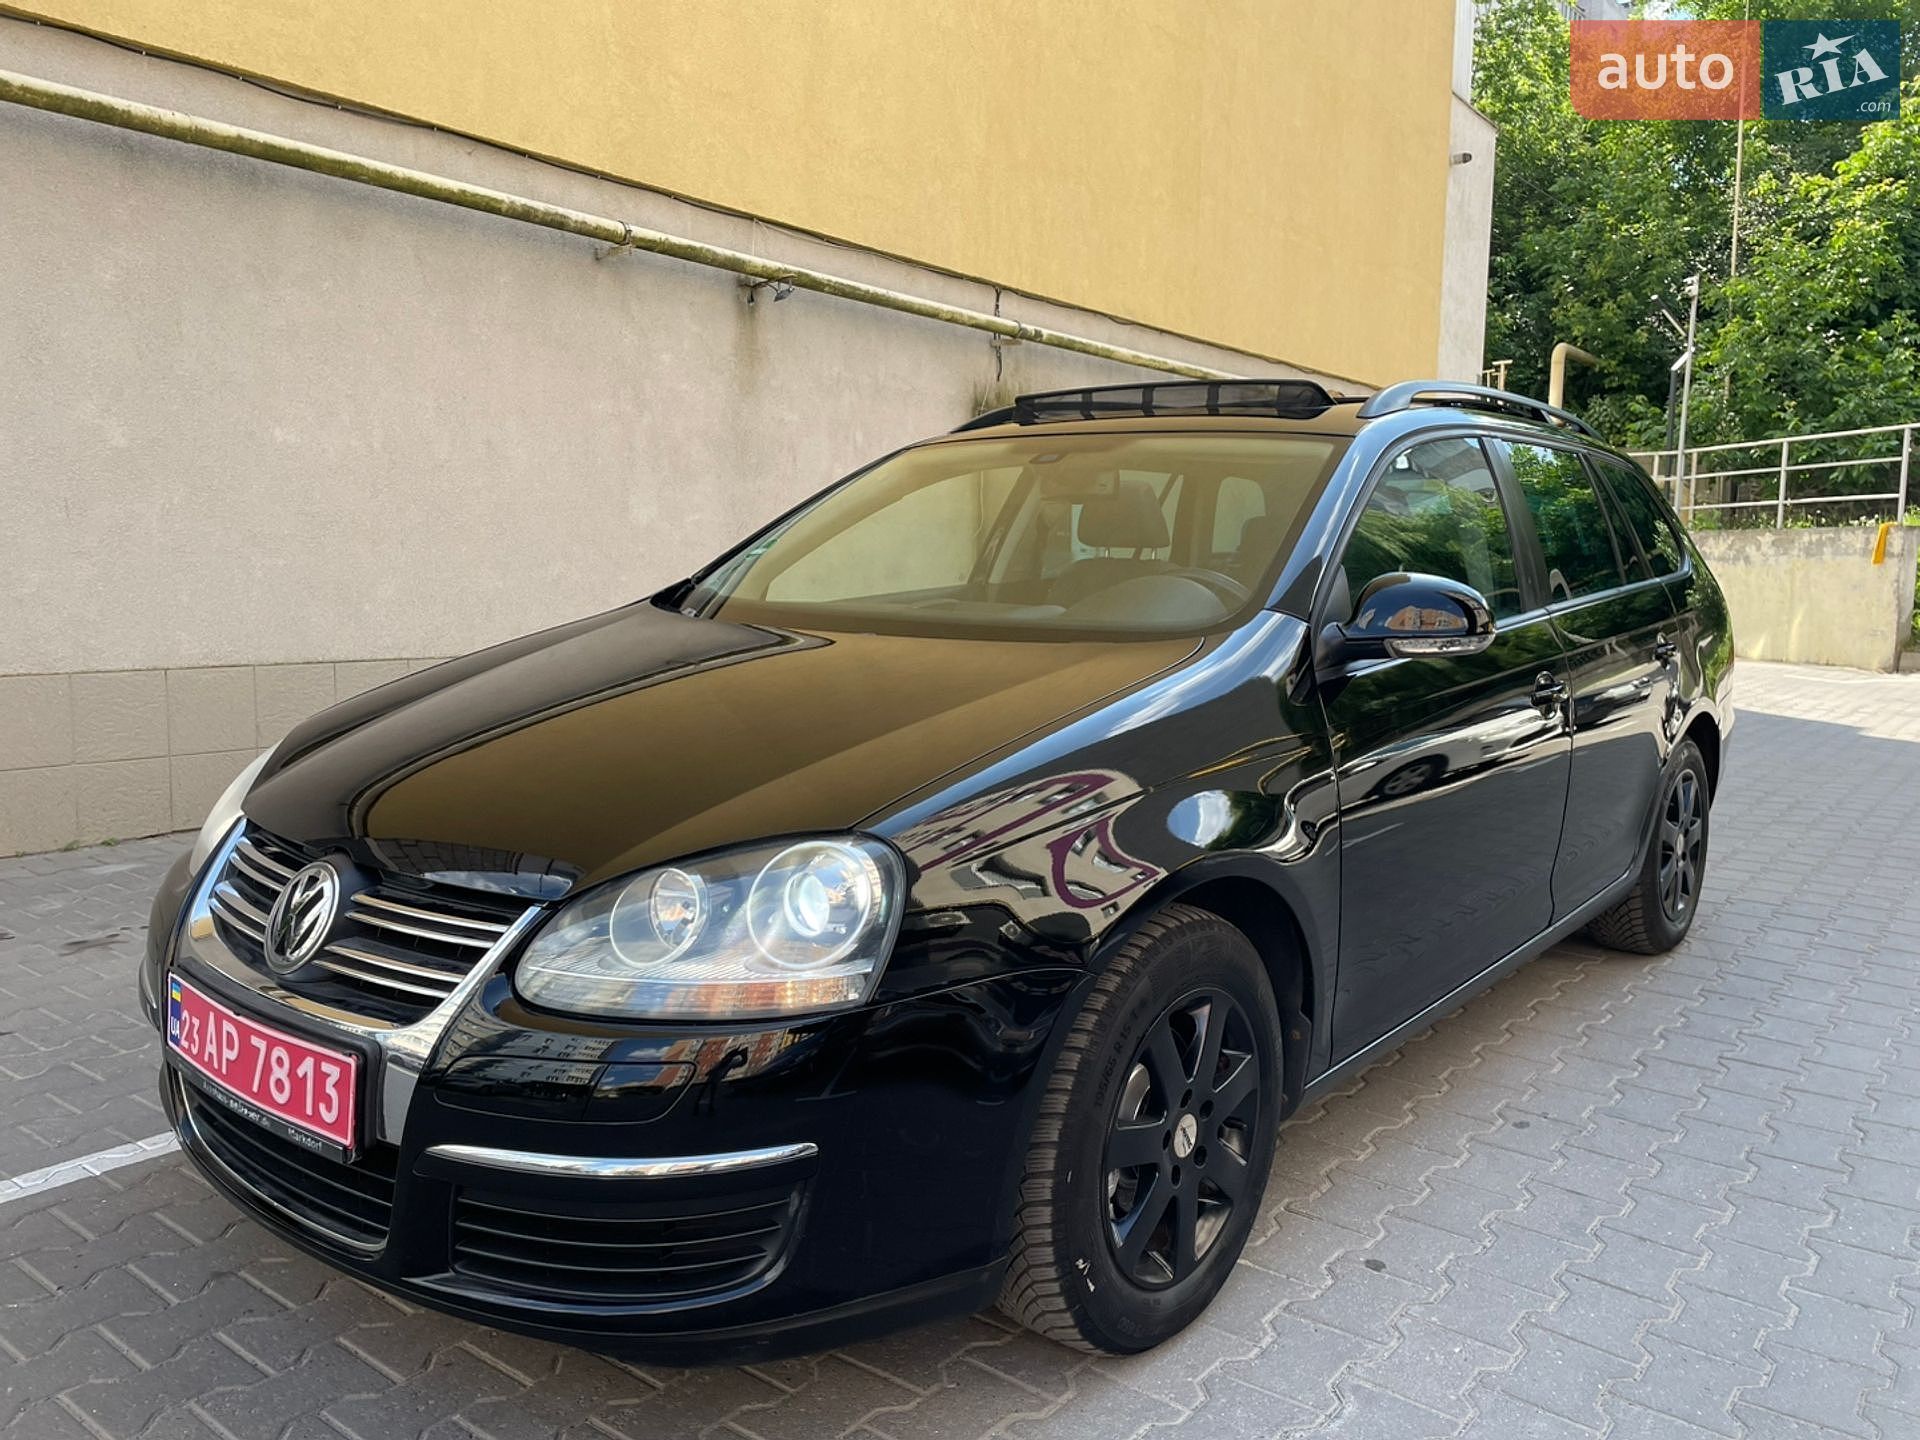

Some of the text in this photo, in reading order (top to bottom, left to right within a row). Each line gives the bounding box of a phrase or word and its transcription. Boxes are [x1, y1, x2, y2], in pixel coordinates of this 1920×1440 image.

[170, 1016, 180, 1039] UA
[181, 1009, 200, 1055] 23
[204, 1010, 240, 1075] AP
[250, 1035, 341, 1124] 7813
